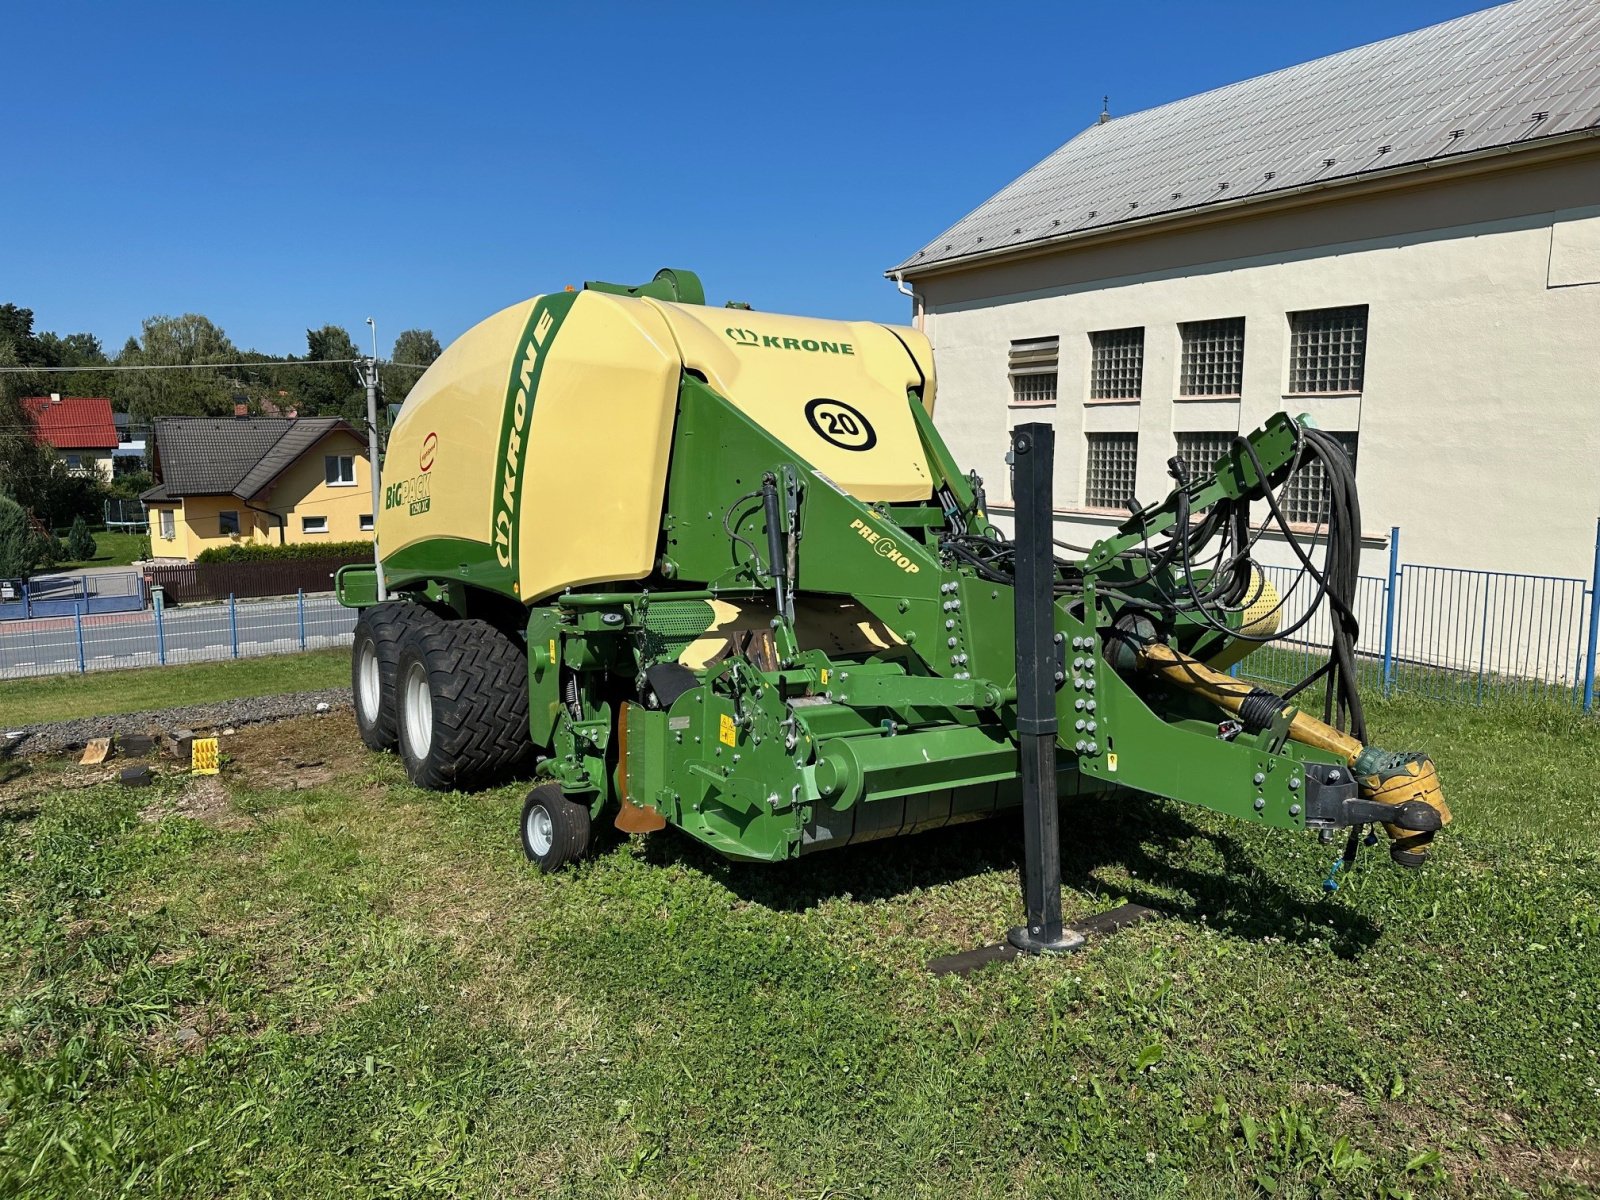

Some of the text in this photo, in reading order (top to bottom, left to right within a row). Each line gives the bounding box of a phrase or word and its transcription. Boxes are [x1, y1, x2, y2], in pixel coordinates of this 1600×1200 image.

[762, 335, 855, 355] KRONE
[503, 307, 554, 514] KRONE
[820, 411, 859, 436] 20
